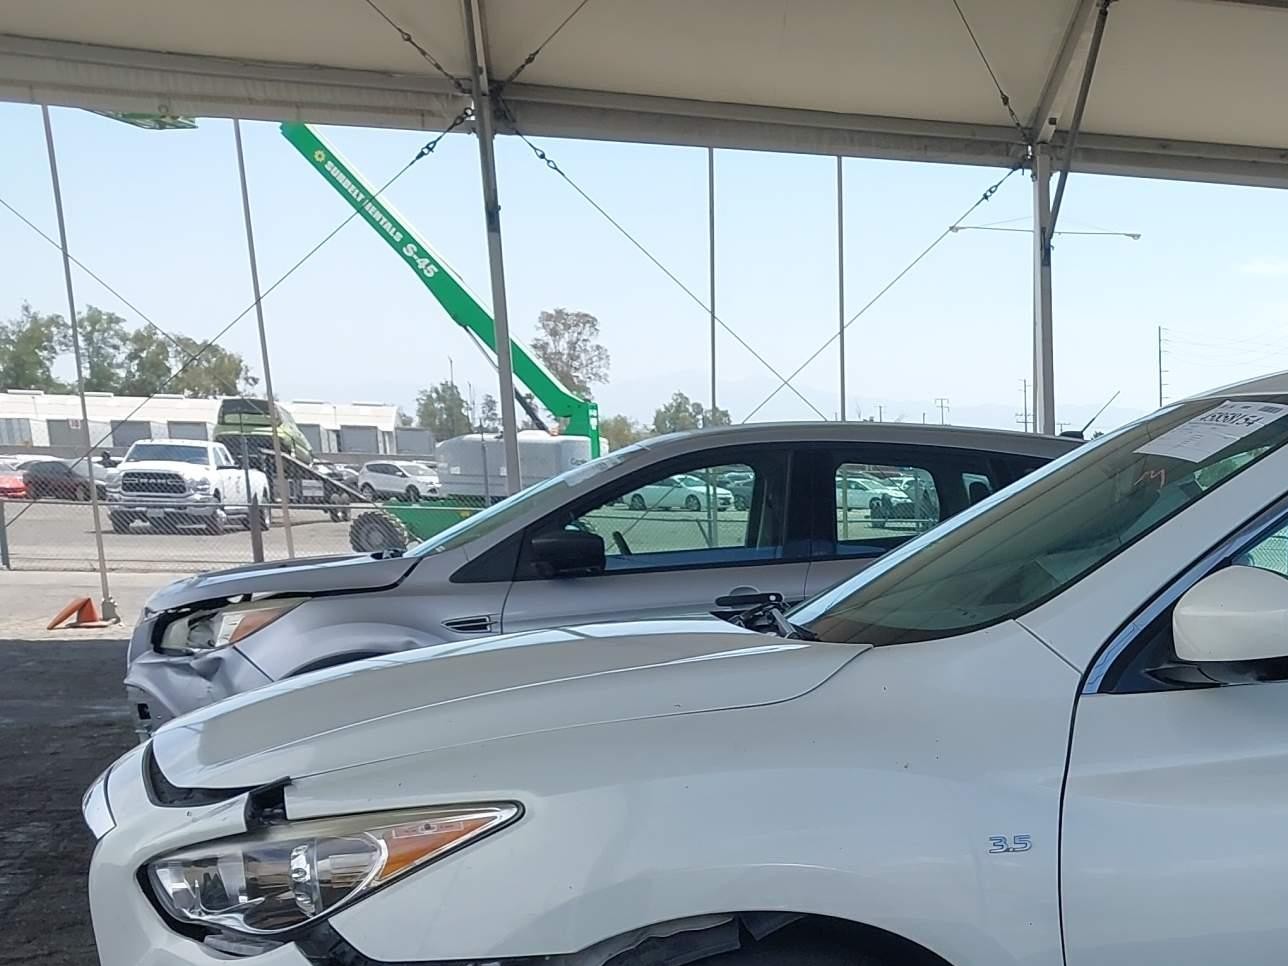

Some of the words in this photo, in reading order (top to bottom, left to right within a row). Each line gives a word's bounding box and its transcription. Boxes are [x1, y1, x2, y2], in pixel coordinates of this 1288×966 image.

[363, 200, 403, 243] RENTALS
[402, 242, 439, 278] S-45
[988, 834, 1033, 854] 3.5
